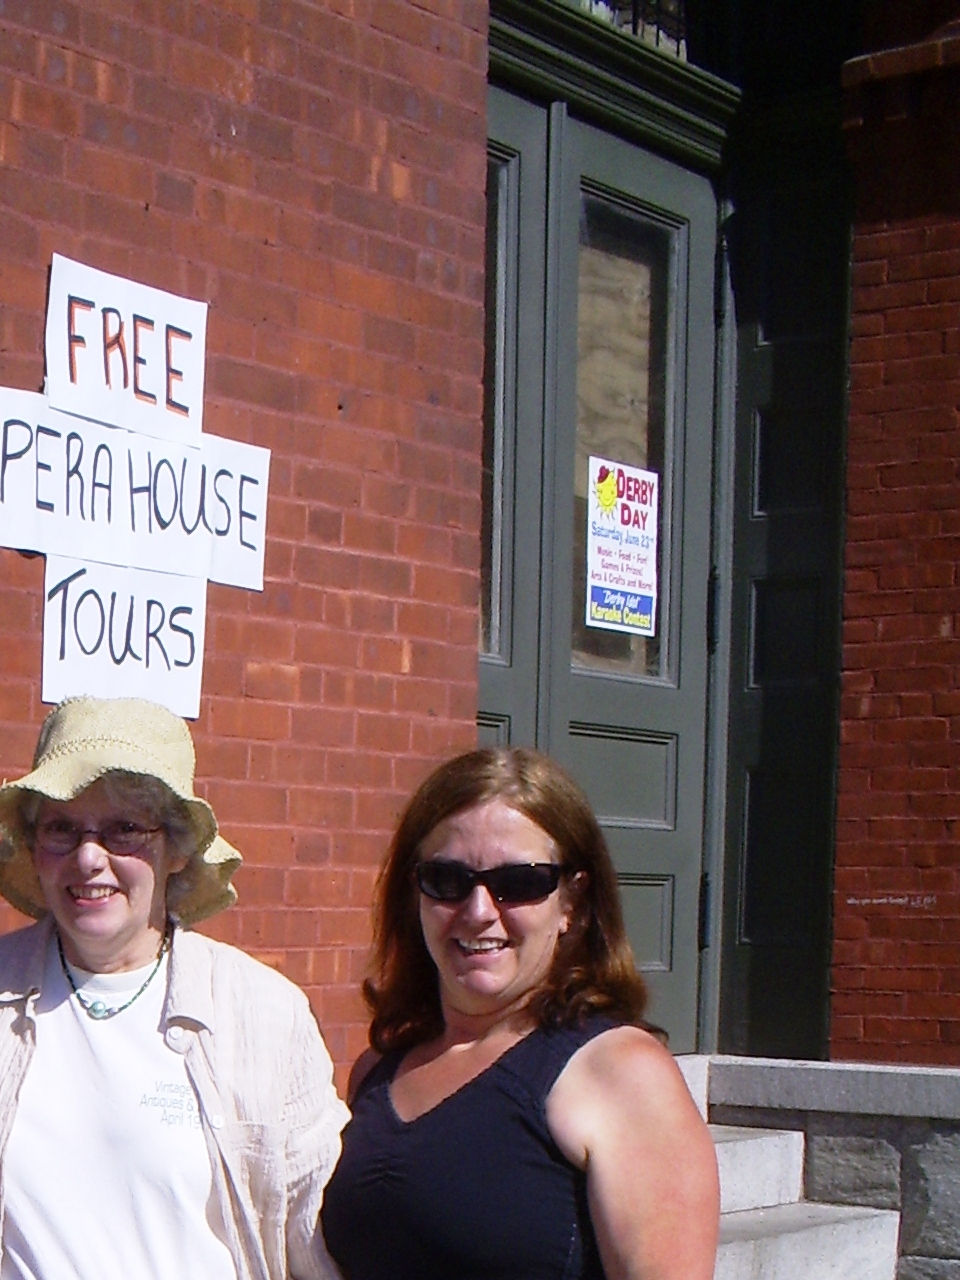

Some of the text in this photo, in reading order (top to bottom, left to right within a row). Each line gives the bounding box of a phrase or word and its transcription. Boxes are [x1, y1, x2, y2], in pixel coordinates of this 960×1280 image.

[67, 294, 193, 418] FREE
[128, 448, 260, 551] HOUSE
[616, 468, 654, 507] DERBY
[620, 503, 648, 531] DAY
[48, 568, 196, 672] TOURS
